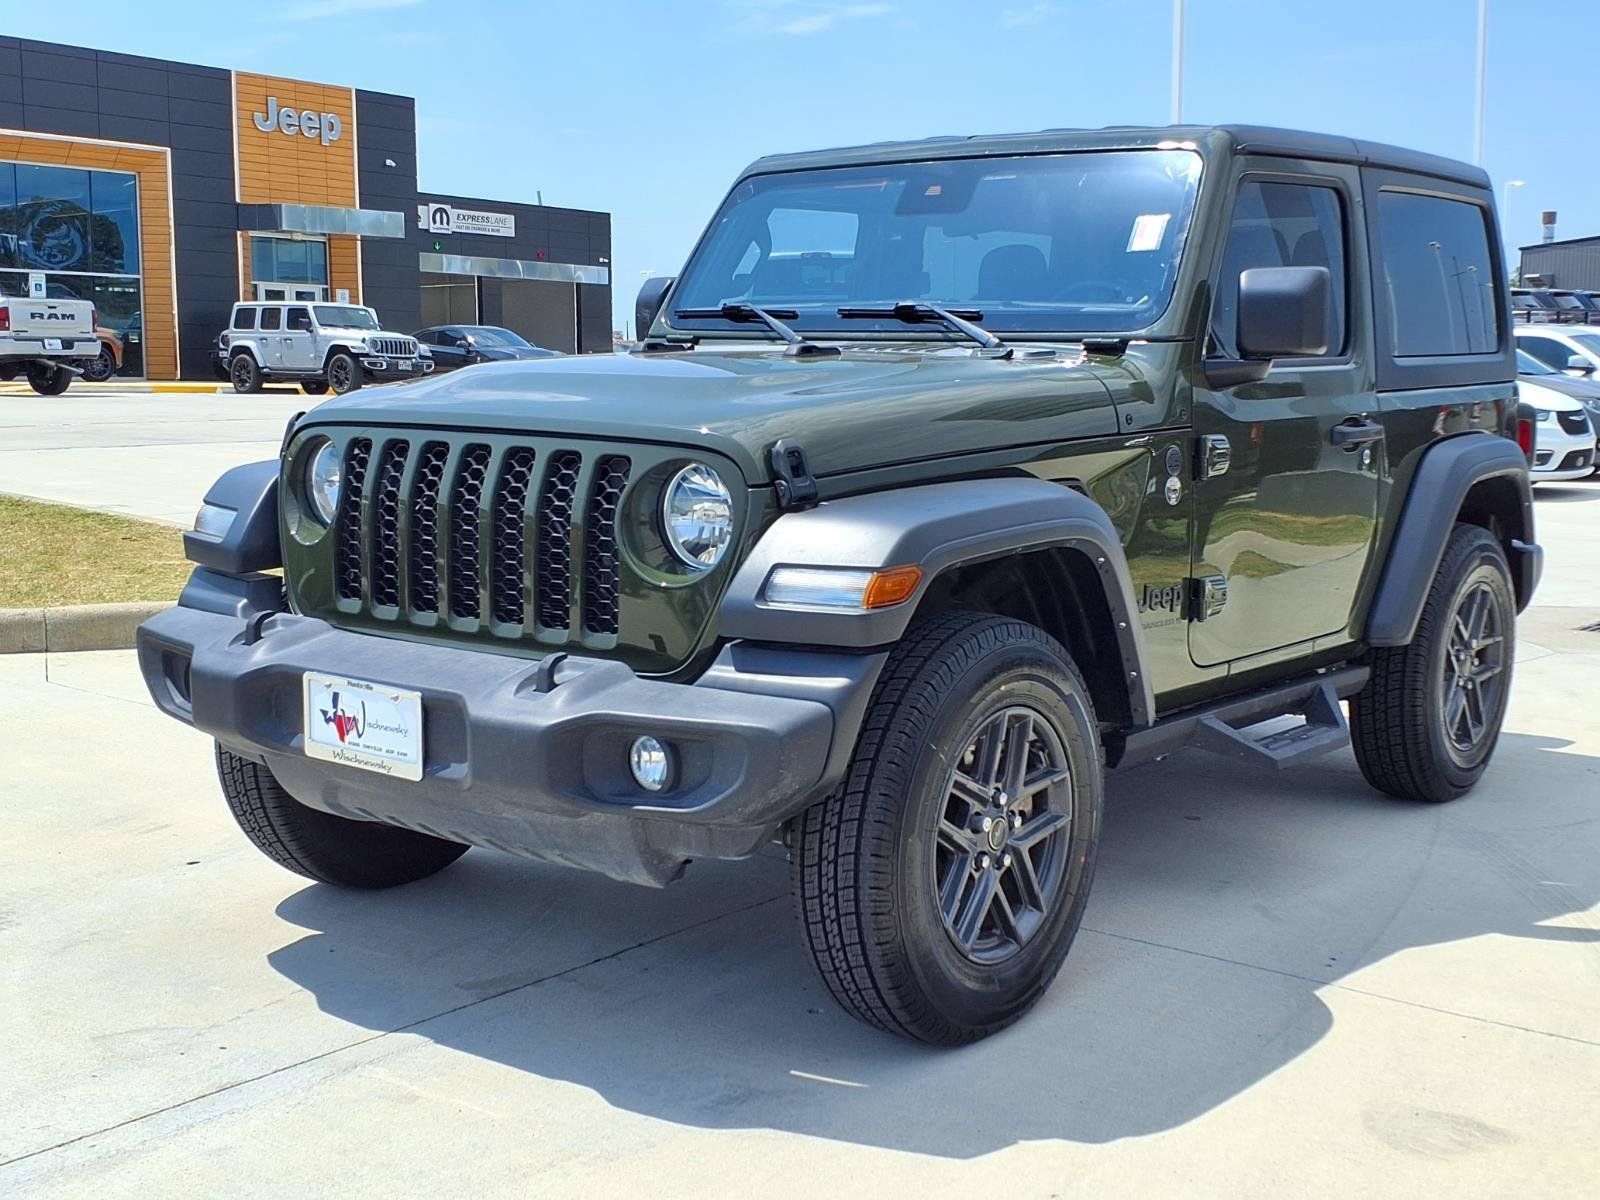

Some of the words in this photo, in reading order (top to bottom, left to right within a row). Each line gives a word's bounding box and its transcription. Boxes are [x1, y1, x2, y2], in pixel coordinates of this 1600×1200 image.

[253, 96, 342, 146] Jeep
[30, 312, 75, 321] RAM
[1137, 583, 1183, 613] Jeep
